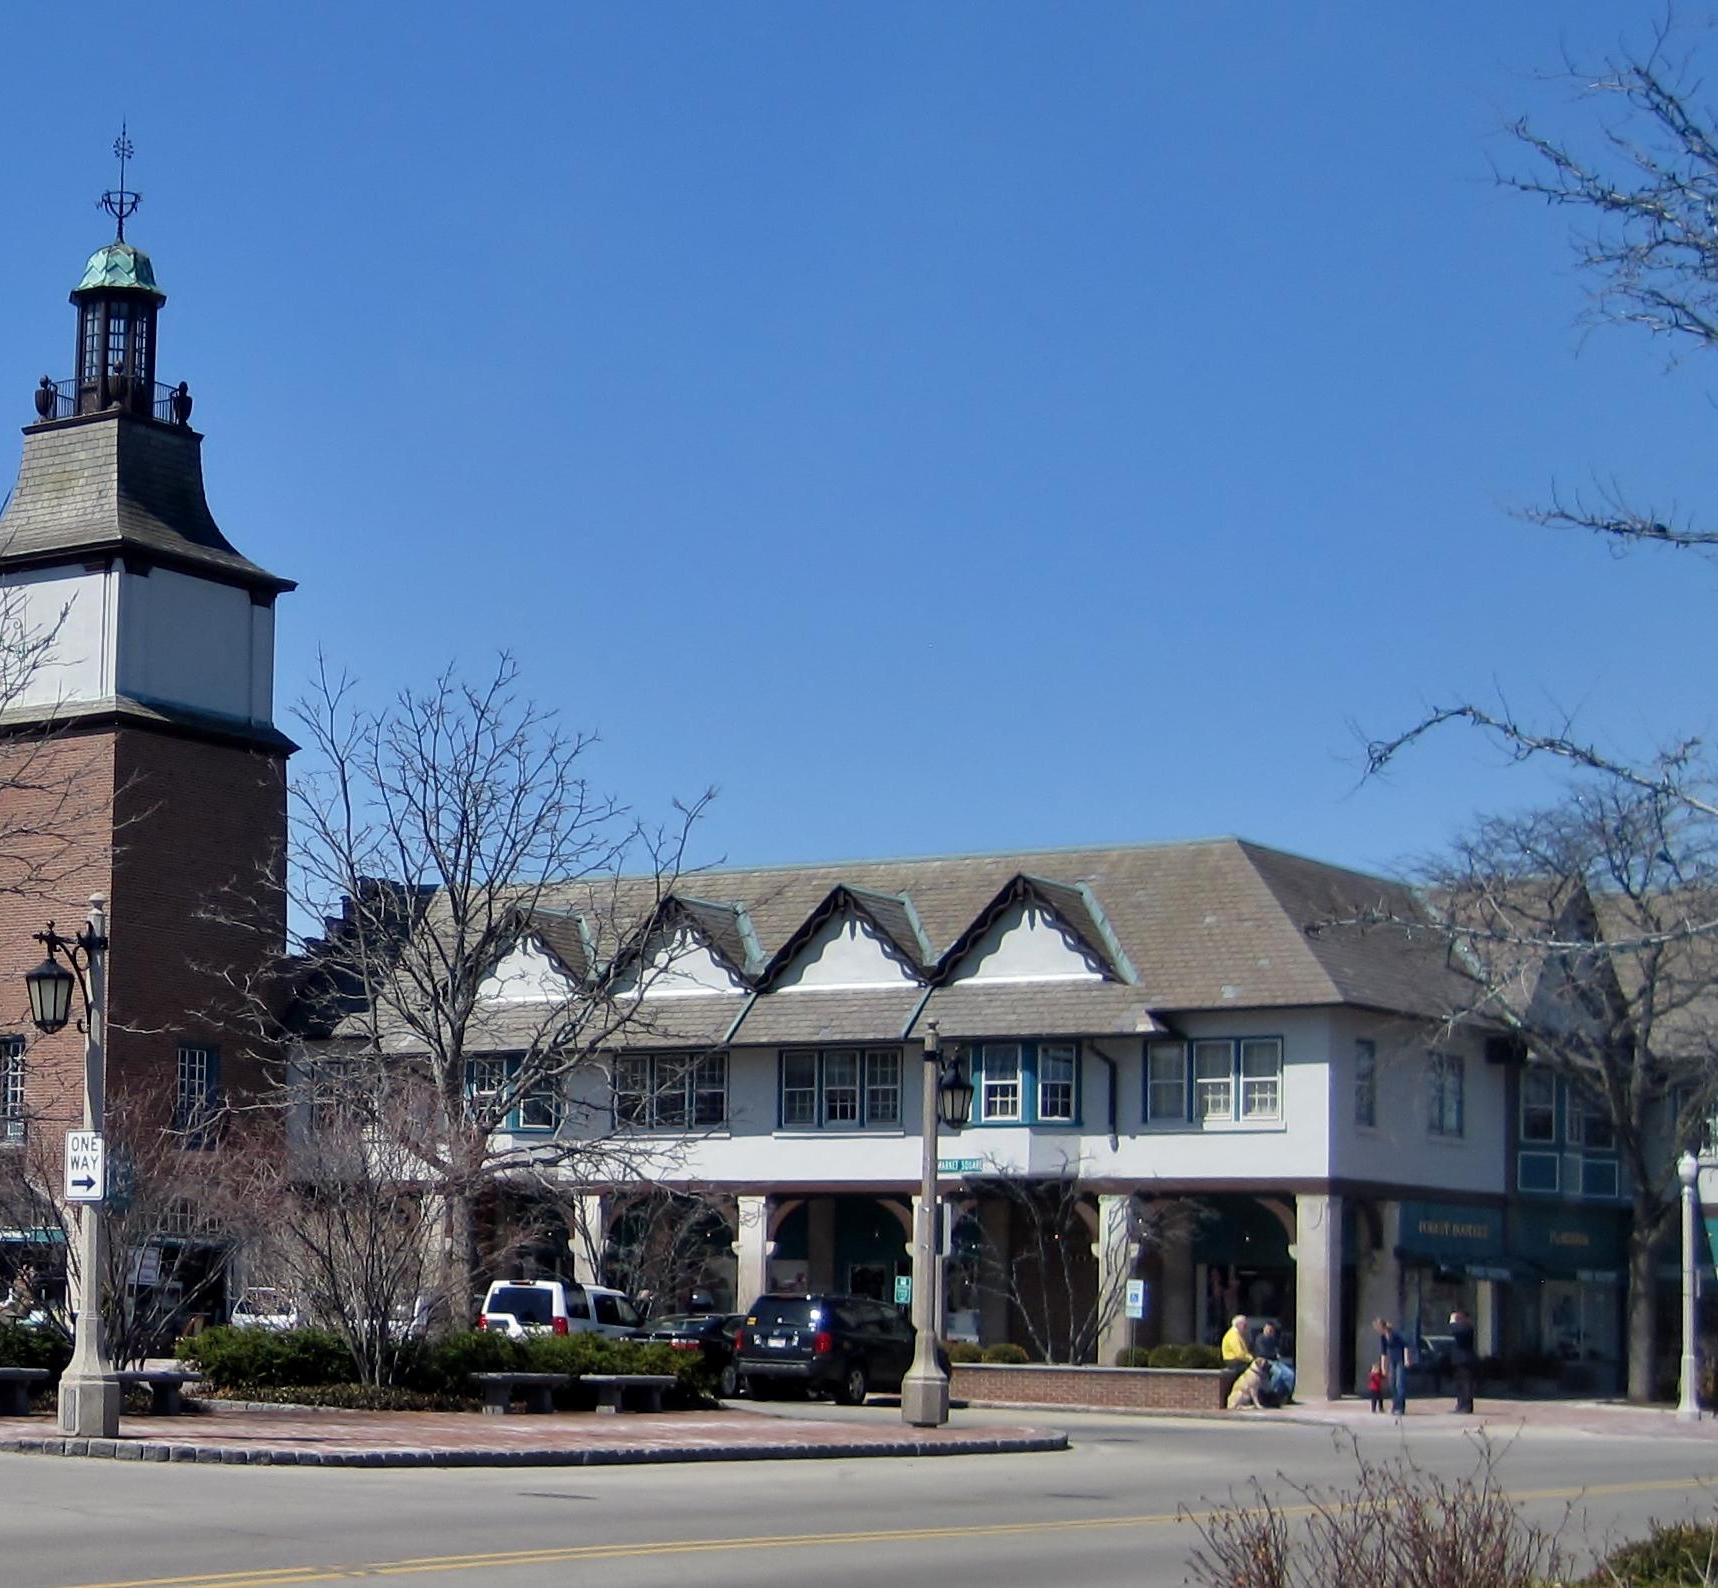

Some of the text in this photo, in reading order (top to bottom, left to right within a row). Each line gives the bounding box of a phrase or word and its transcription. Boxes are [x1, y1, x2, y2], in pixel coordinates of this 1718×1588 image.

[71, 1136, 99, 1152] ONE
[70, 1155, 99, 1171] WAY
[961, 1159, 984, 1170] SQUARE
